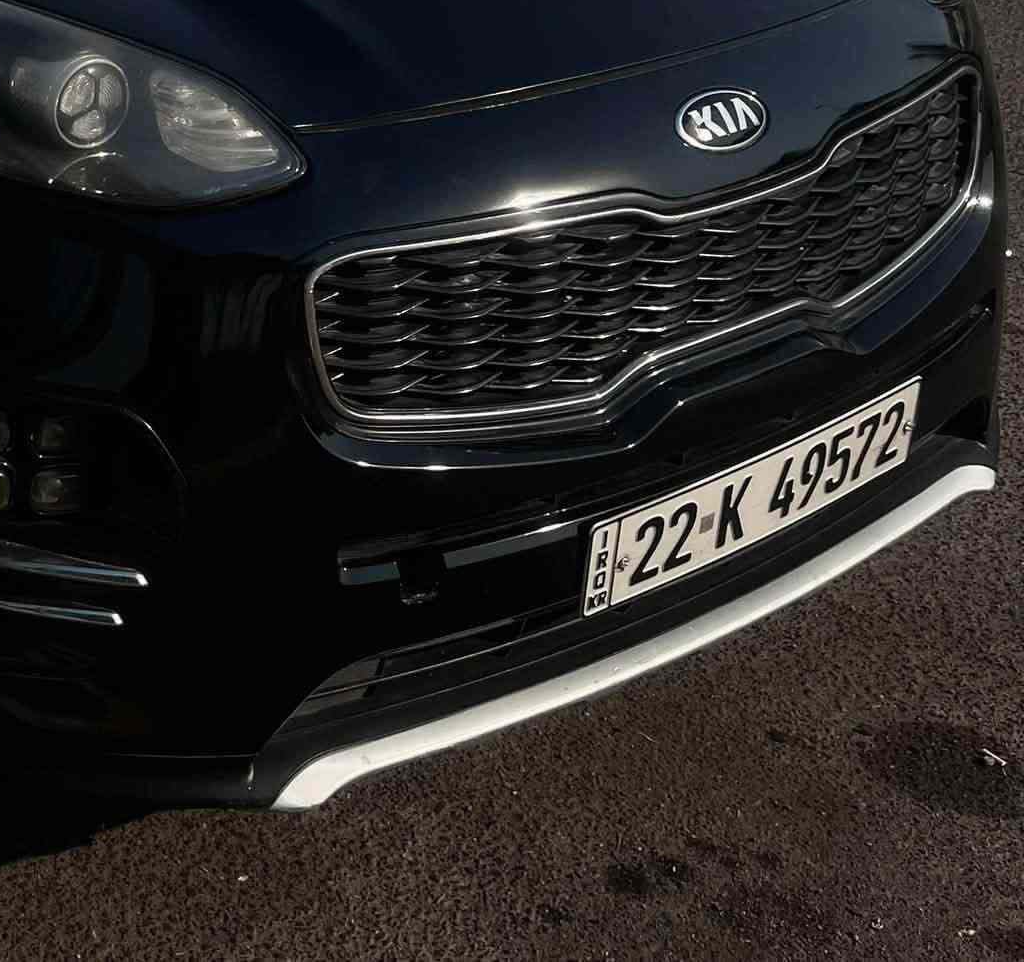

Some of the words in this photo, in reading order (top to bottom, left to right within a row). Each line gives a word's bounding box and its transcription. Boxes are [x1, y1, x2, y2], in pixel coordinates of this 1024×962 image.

[687, 97, 761, 143] KIA
[629, 502, 698, 587] 22
[714, 475, 753, 549] K
[767, 401, 906, 519] 49572
